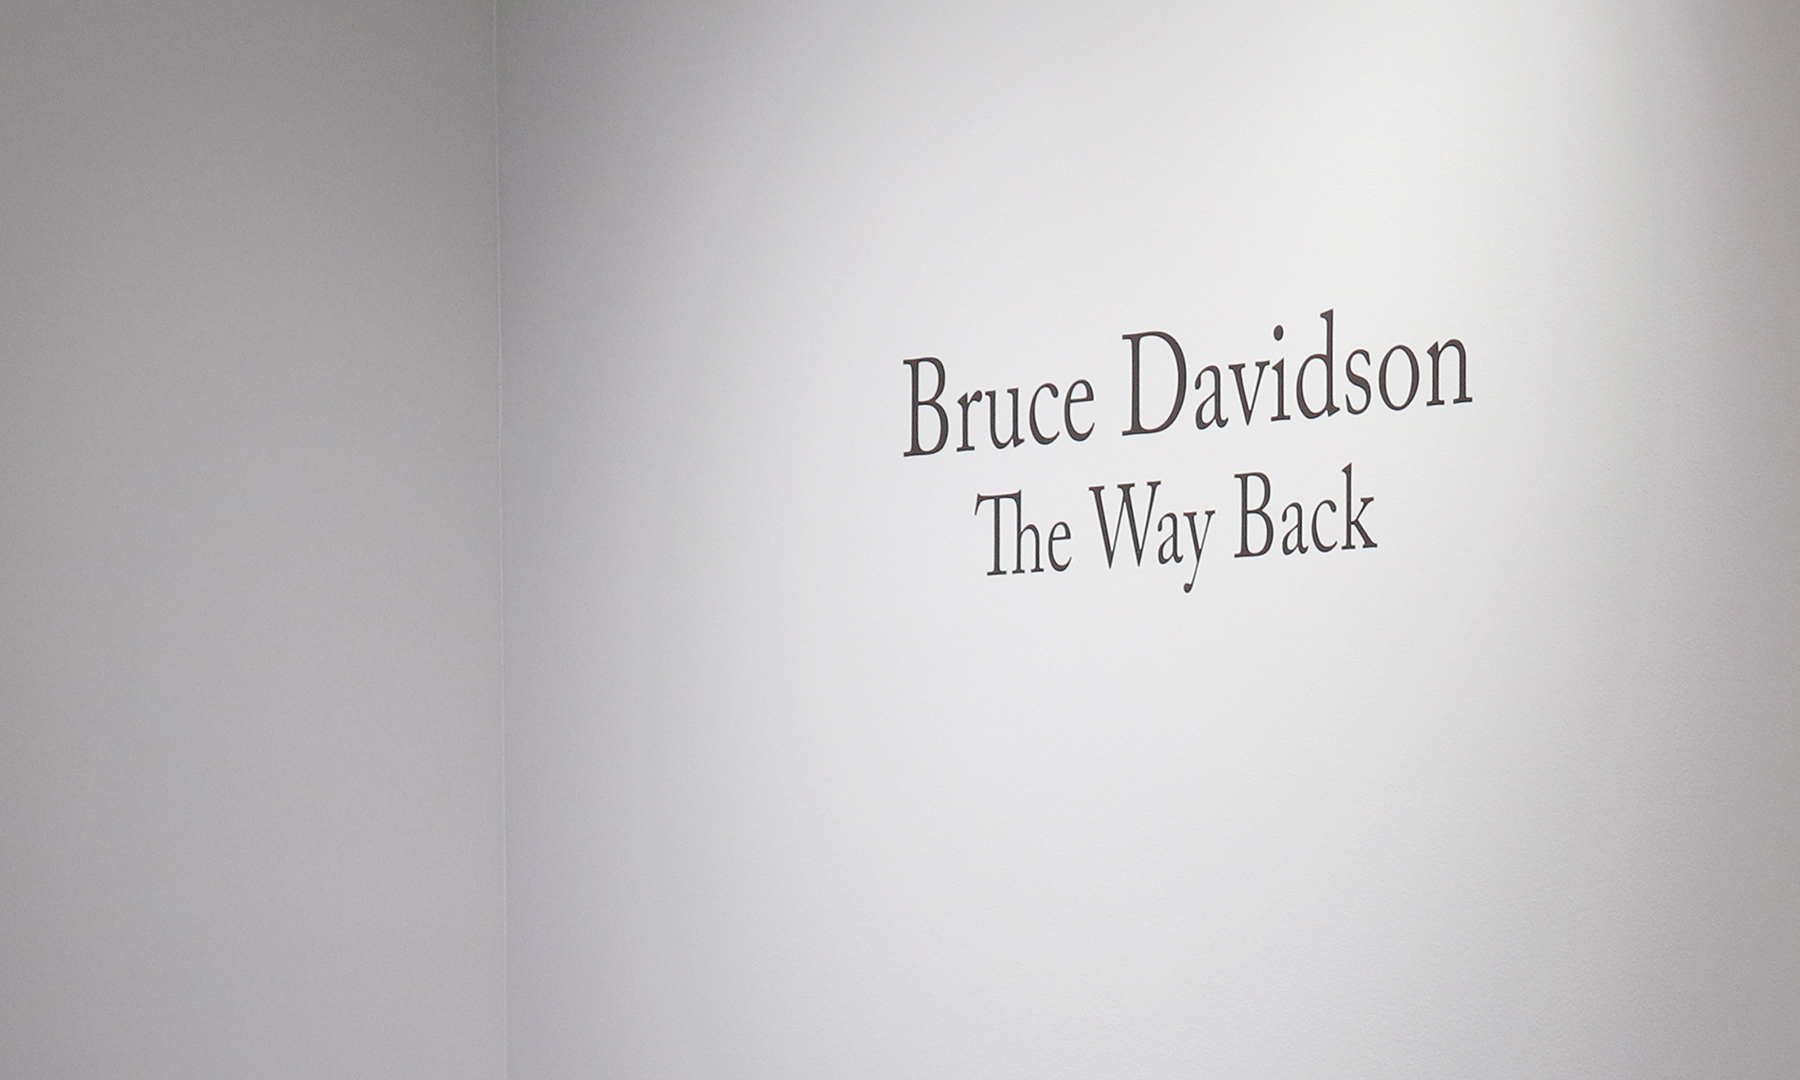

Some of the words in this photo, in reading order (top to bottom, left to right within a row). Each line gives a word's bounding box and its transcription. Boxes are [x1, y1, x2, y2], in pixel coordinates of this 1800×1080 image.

[903, 357, 1095, 458] Bruce
[1121, 309, 1473, 437] Davidson
[974, 489, 1072, 576] The
[1088, 480, 1216, 594] Way
[1234, 462, 1378, 558] Back
